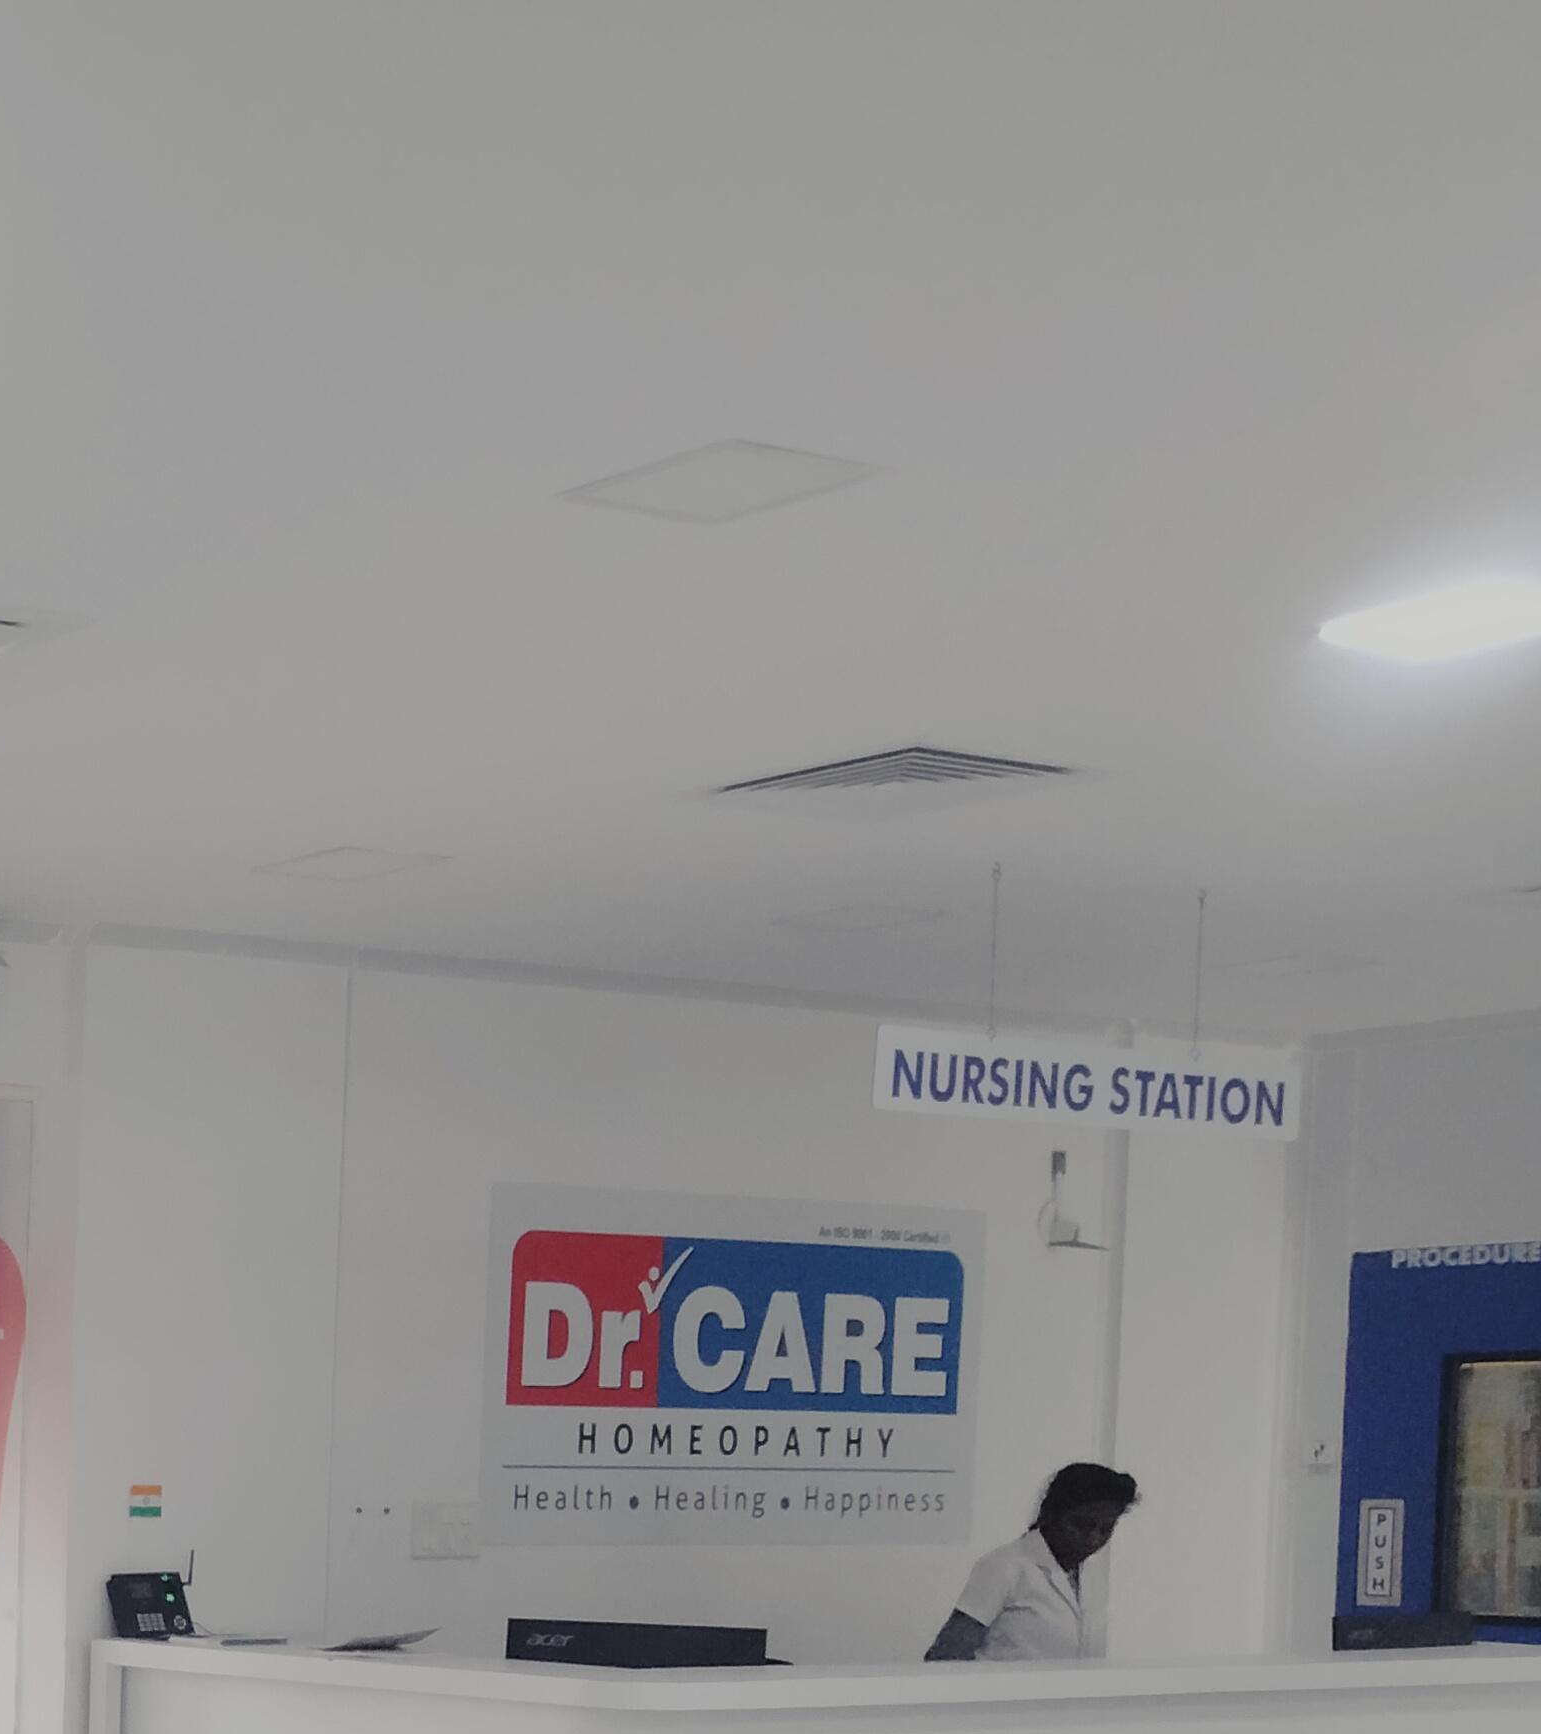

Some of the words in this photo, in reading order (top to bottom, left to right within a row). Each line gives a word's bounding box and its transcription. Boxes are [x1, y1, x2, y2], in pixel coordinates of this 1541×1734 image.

[891, 1049, 1095, 1112] NURSING
[1108, 1067, 1285, 1127] STATION
[1391, 1241, 1541, 1268] PROCEDURE
[520, 1280, 644, 1389] Dr.
[672, 1285, 951, 1397] CARE
[577, 1422, 895, 1458] HOMEOPATHY
[513, 1484, 614, 1511] Health
[654, 1485, 767, 1518] Healing
[804, 1485, 946, 1519] Happiness
[1372, 1513, 1387, 1591] PUSH
[526, 1632, 574, 1647] acer
